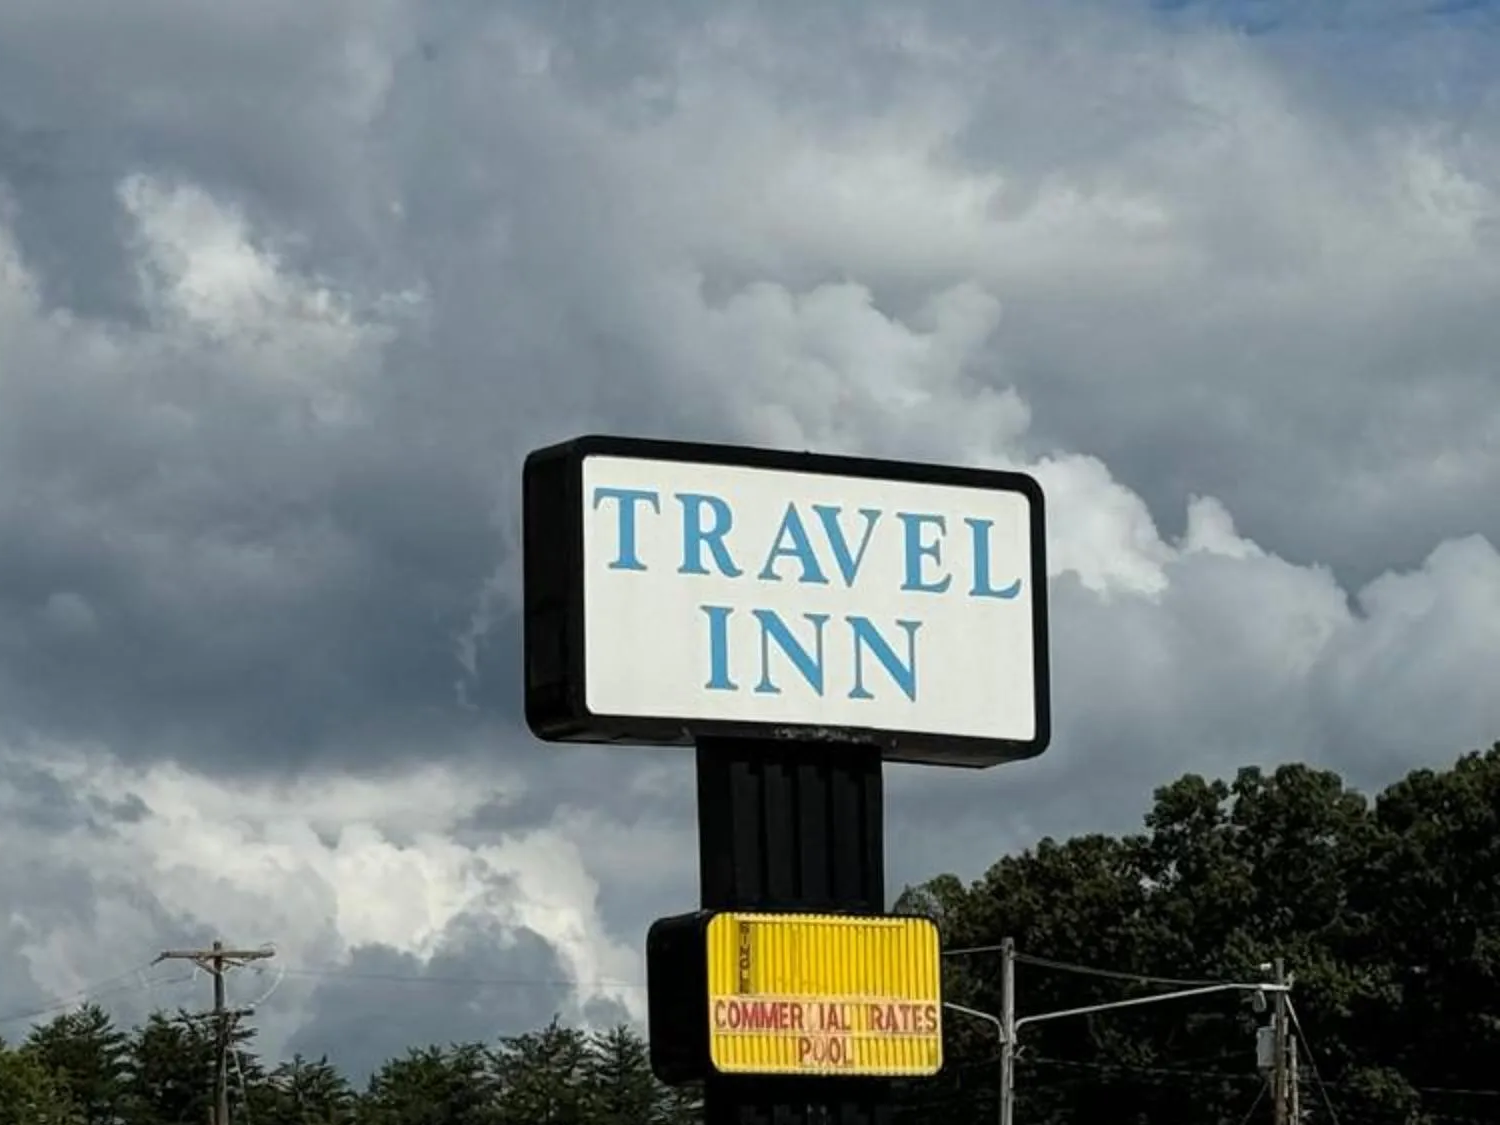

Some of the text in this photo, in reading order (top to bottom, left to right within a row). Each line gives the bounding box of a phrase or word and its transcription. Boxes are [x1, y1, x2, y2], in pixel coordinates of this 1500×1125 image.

[593, 487, 1021, 599] TRAVEL
[700, 604, 923, 702] INN
[714, 1002, 937, 1033] COMMERIAL RATES
[799, 1036, 852, 1064] POOL
